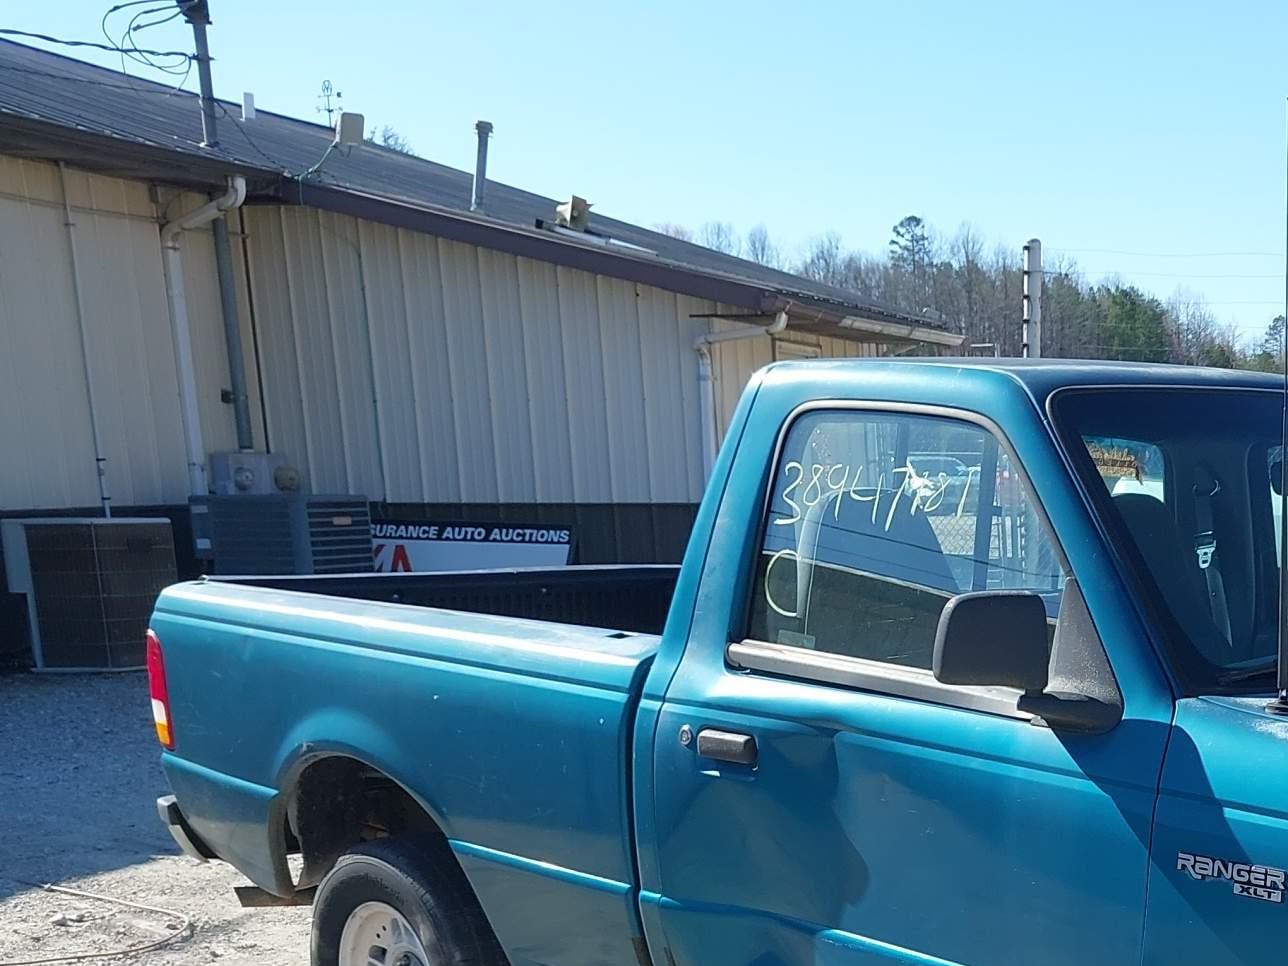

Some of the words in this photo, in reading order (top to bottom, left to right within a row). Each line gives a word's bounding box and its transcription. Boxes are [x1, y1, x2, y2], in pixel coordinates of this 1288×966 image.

[442, 526, 486, 540] AUTO
[489, 528, 570, 542] AUCTIONS
[1177, 852, 1286, 890] RANGER
[1237, 884, 1279, 901] XLT
